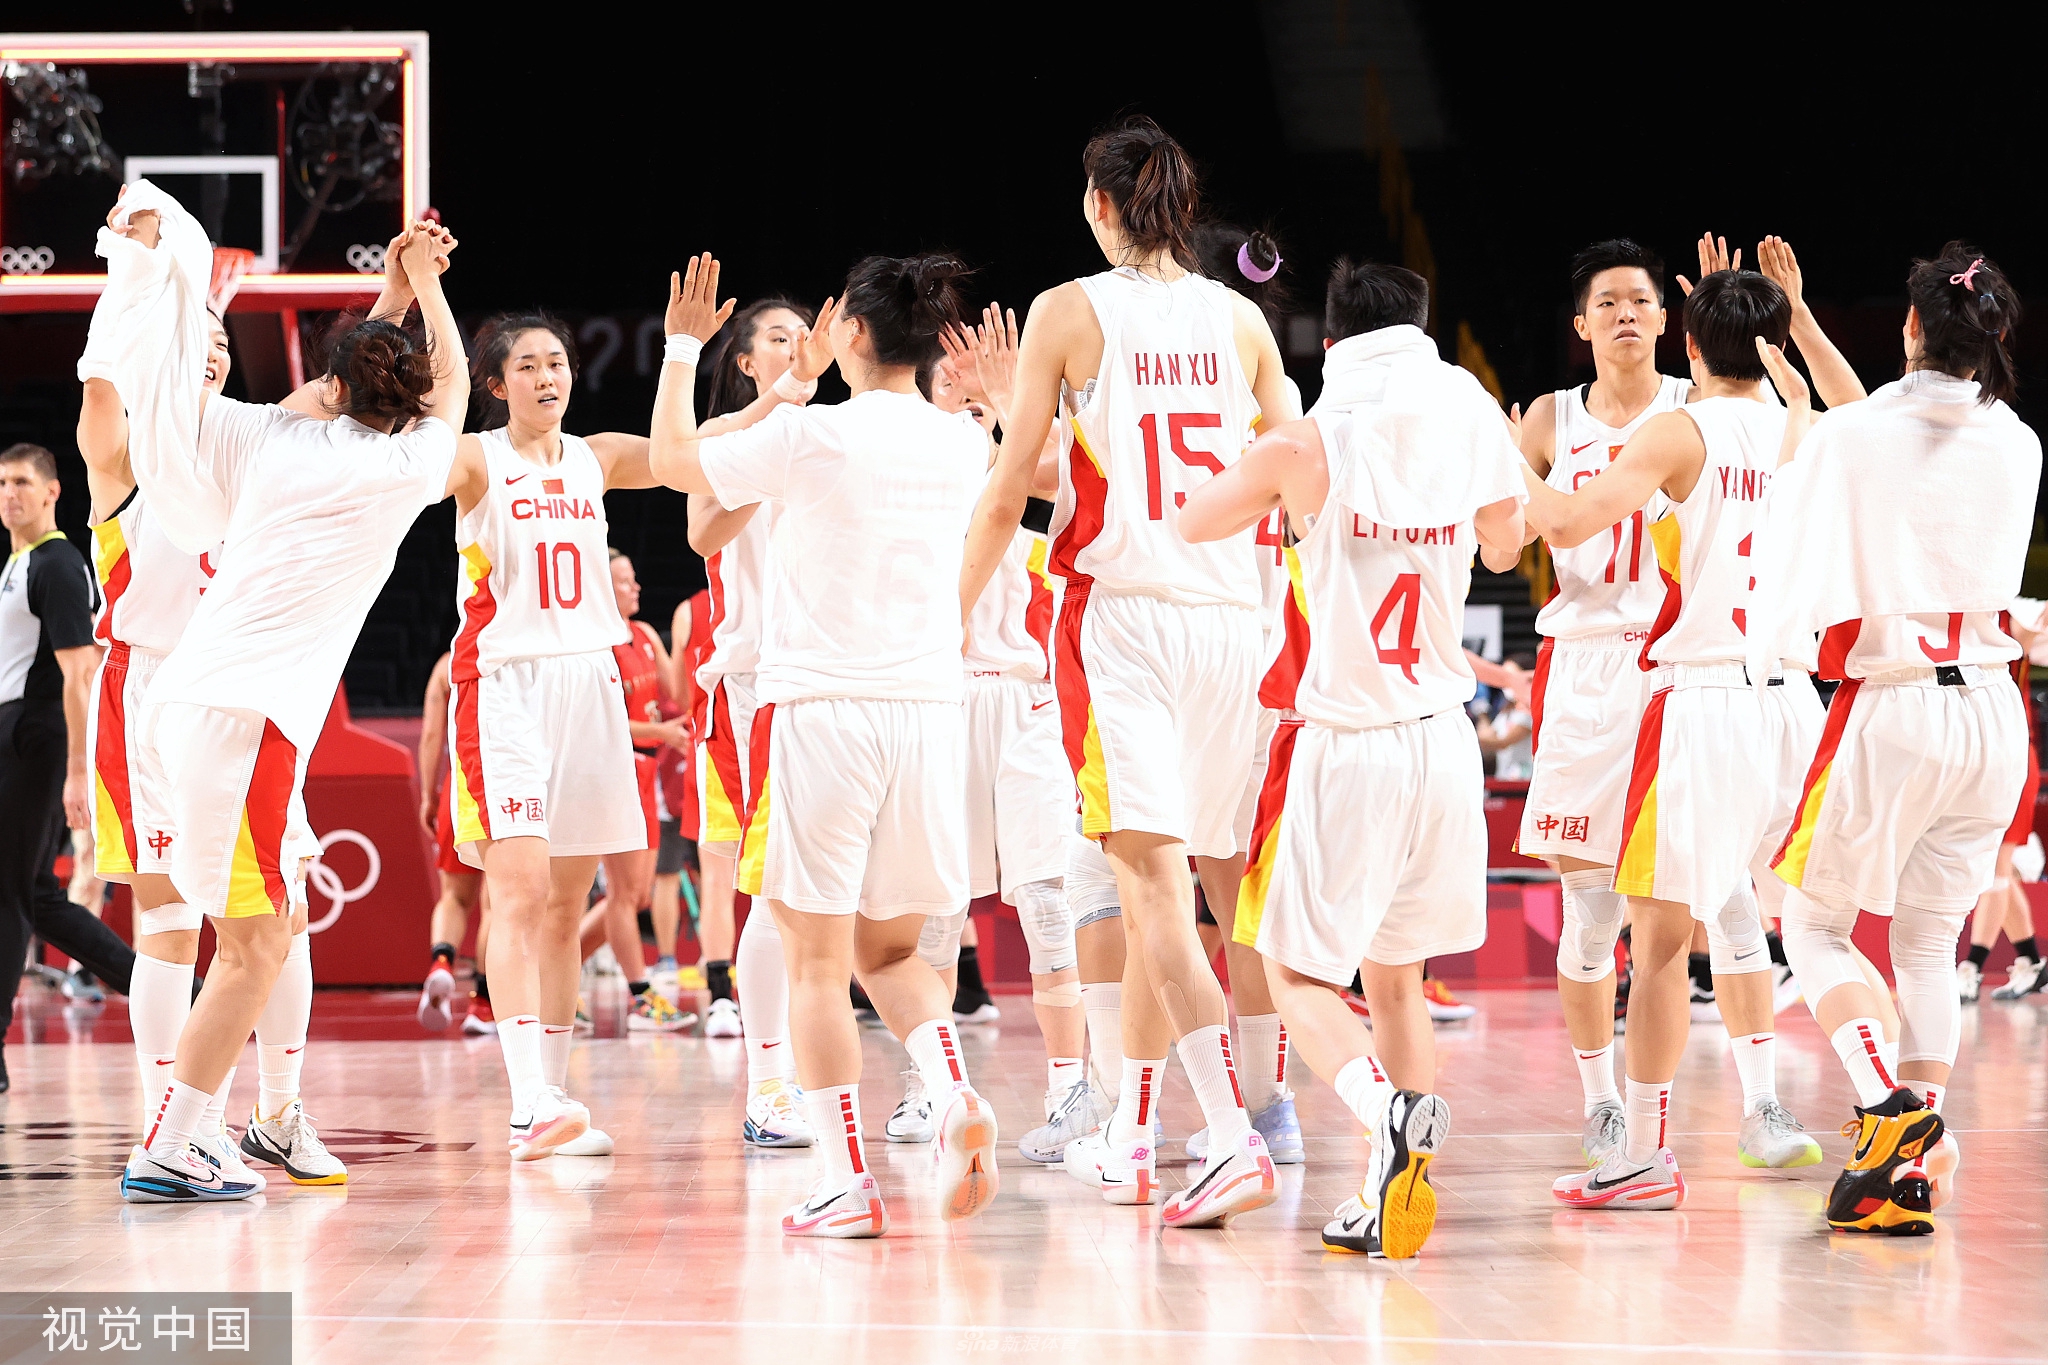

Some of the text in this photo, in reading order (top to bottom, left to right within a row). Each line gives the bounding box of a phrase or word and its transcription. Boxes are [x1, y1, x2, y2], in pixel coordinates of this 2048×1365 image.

[1135, 353, 1218, 386] HAN XU
[1138, 413, 1226, 520] 15
[511, 498, 596, 520] CHINA
[1605, 510, 1643, 583] 11
[535, 542, 582, 610] 10
[1370, 573, 1421, 686] 4
[501, 797, 543, 823] 中国
[1536, 814, 1590, 843] 中国
